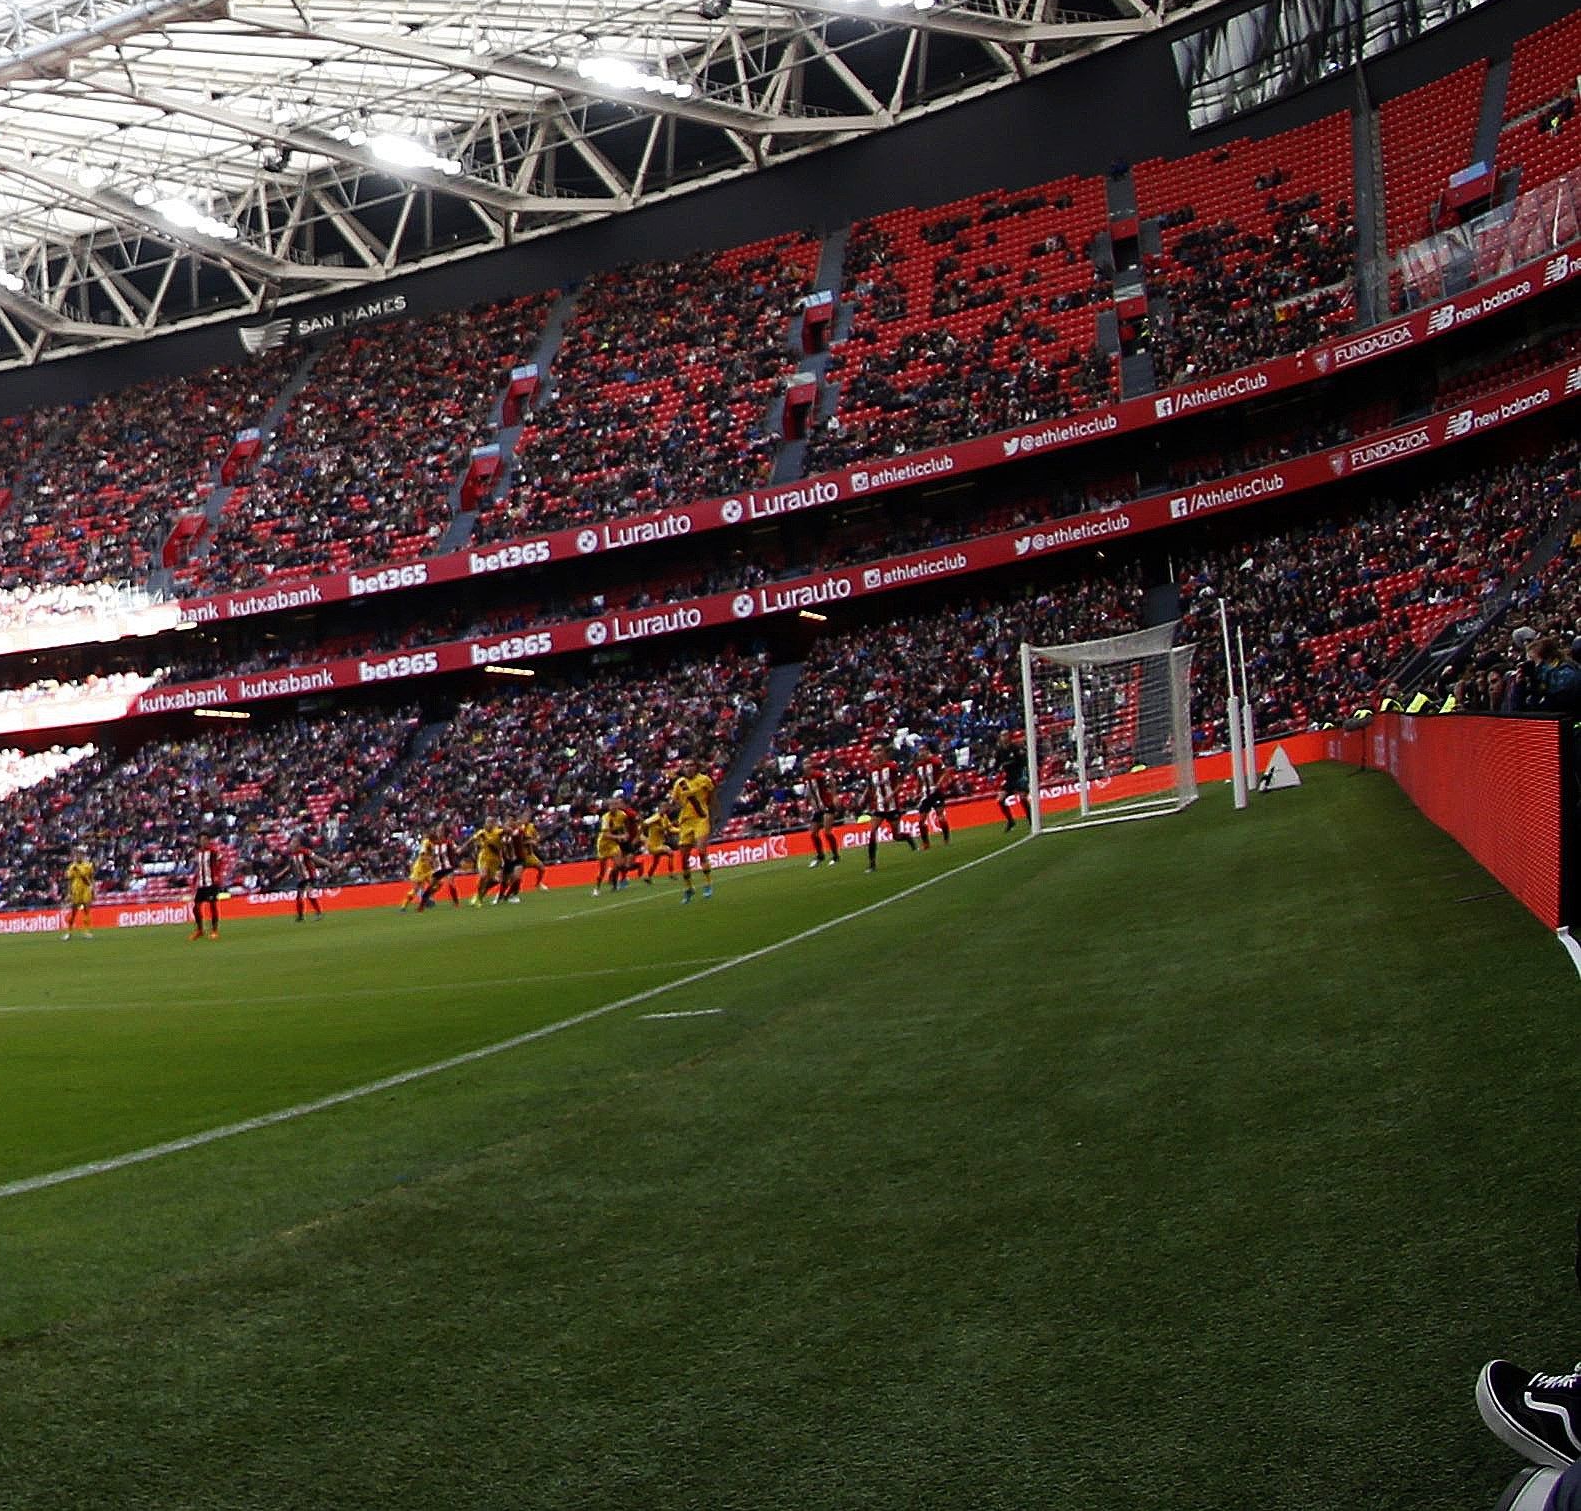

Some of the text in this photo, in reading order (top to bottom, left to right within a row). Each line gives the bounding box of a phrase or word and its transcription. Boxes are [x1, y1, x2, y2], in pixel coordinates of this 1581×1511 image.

[1455, 303, 1482, 323] new
[1482, 281, 1531, 311] balance
[298, 314, 335, 336] SAN
[1334, 326, 1413, 364] FUNDAZIOA
[1175, 372, 1268, 412] /AthleticClub
[1473, 410, 1499, 429] new
[1500, 389, 1550, 419] balance
[1020, 414, 1118, 451] @athleticclub
[1350, 430, 1431, 466] FUNDAZIOA
[870, 455, 954, 488] athleticclub
[749, 481, 839, 519] Lurauto
[1189, 474, 1284, 513] /AthleticClub
[603, 514, 691, 550] Lurauto
[1031, 514, 1130, 551] @athleticclub
[470, 540, 551, 575] bet365
[882, 552, 968, 585] athleticclub
[348, 563, 429, 596] bet365
[761, 576, 852, 614] Lurauto
[229, 584, 322, 618] kutxabank
[613, 606, 702, 642] Lurauto
[471, 631, 553, 666] bet365
[241, 668, 334, 699] kutxabank
[359, 652, 438, 682] bet365
[139, 684, 229, 713] kutxabank
[119, 902, 190, 928] euskaltel
